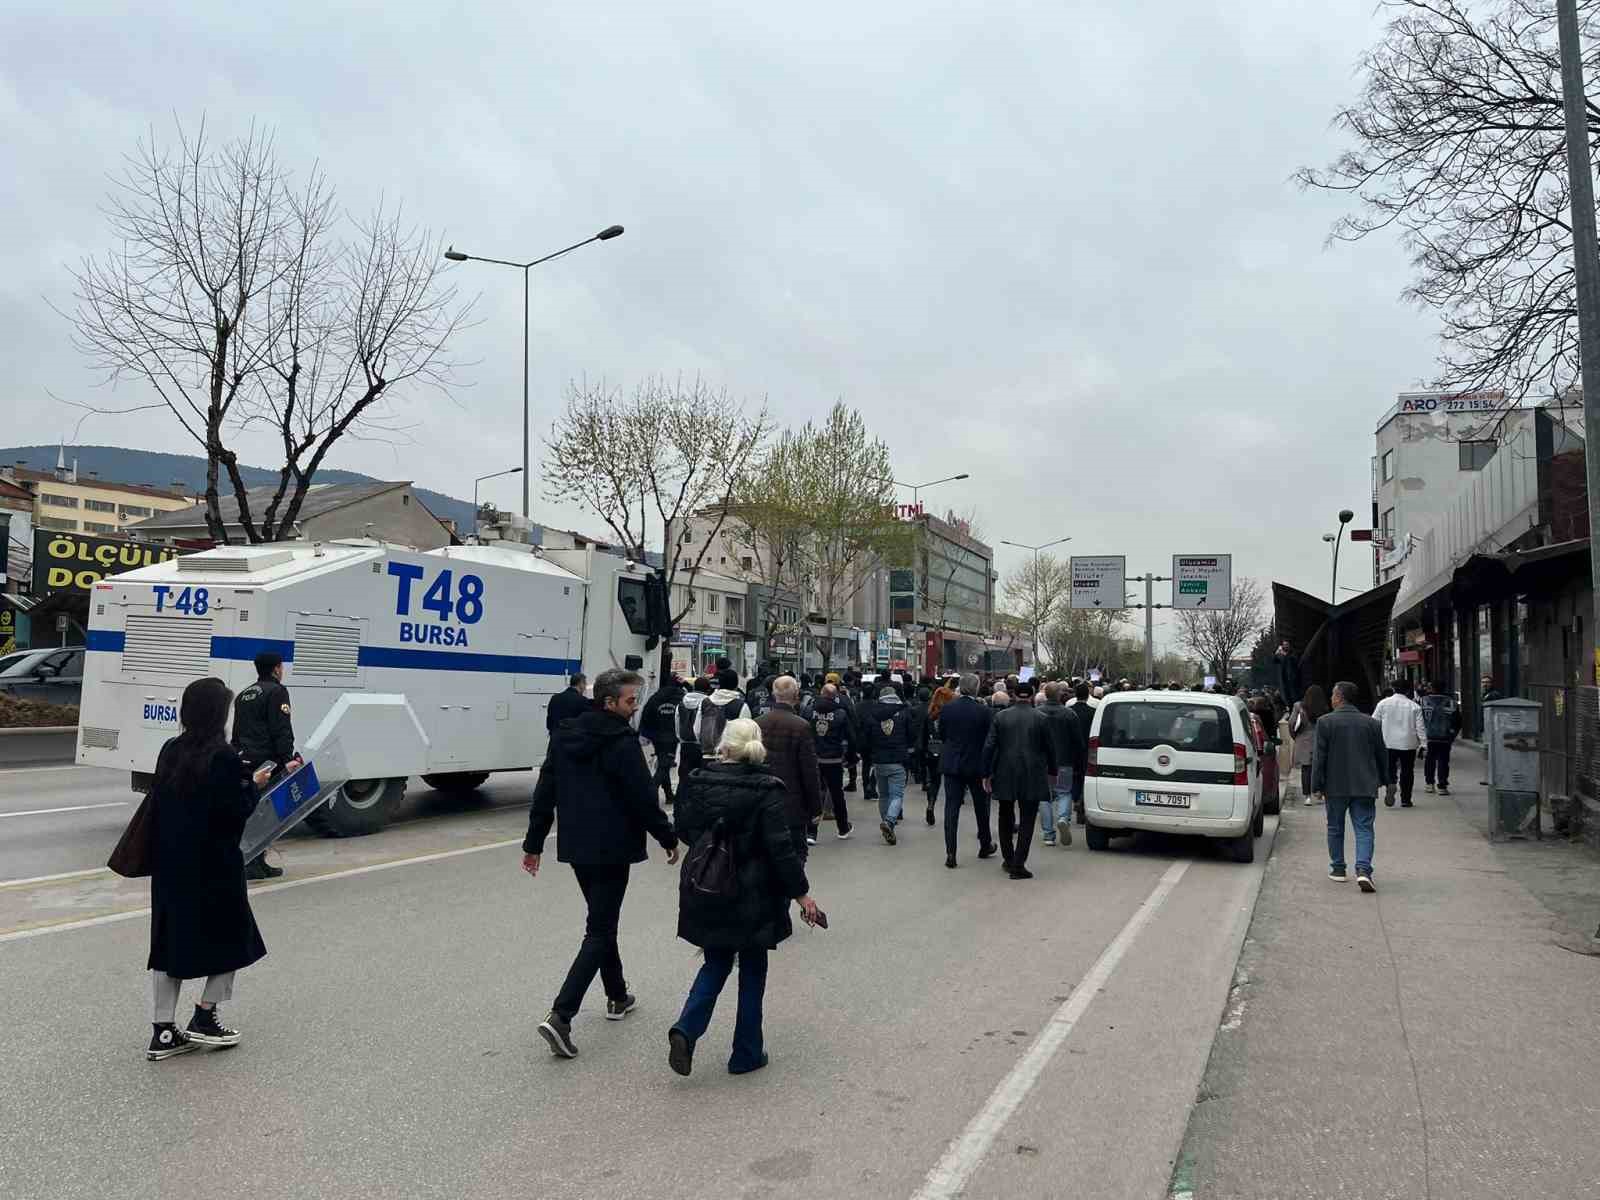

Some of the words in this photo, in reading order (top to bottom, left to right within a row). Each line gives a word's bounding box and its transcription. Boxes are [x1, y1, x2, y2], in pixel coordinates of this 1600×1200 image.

[1402, 399, 1437, 411] ARO
[47, 567, 111, 590] DO
[387, 560, 484, 625] T48
[399, 622, 468, 647] BURSA
[143, 703, 178, 722] BURSA
[1140, 792, 1152, 803] 34
[1167, 795, 1188, 806] 7091
